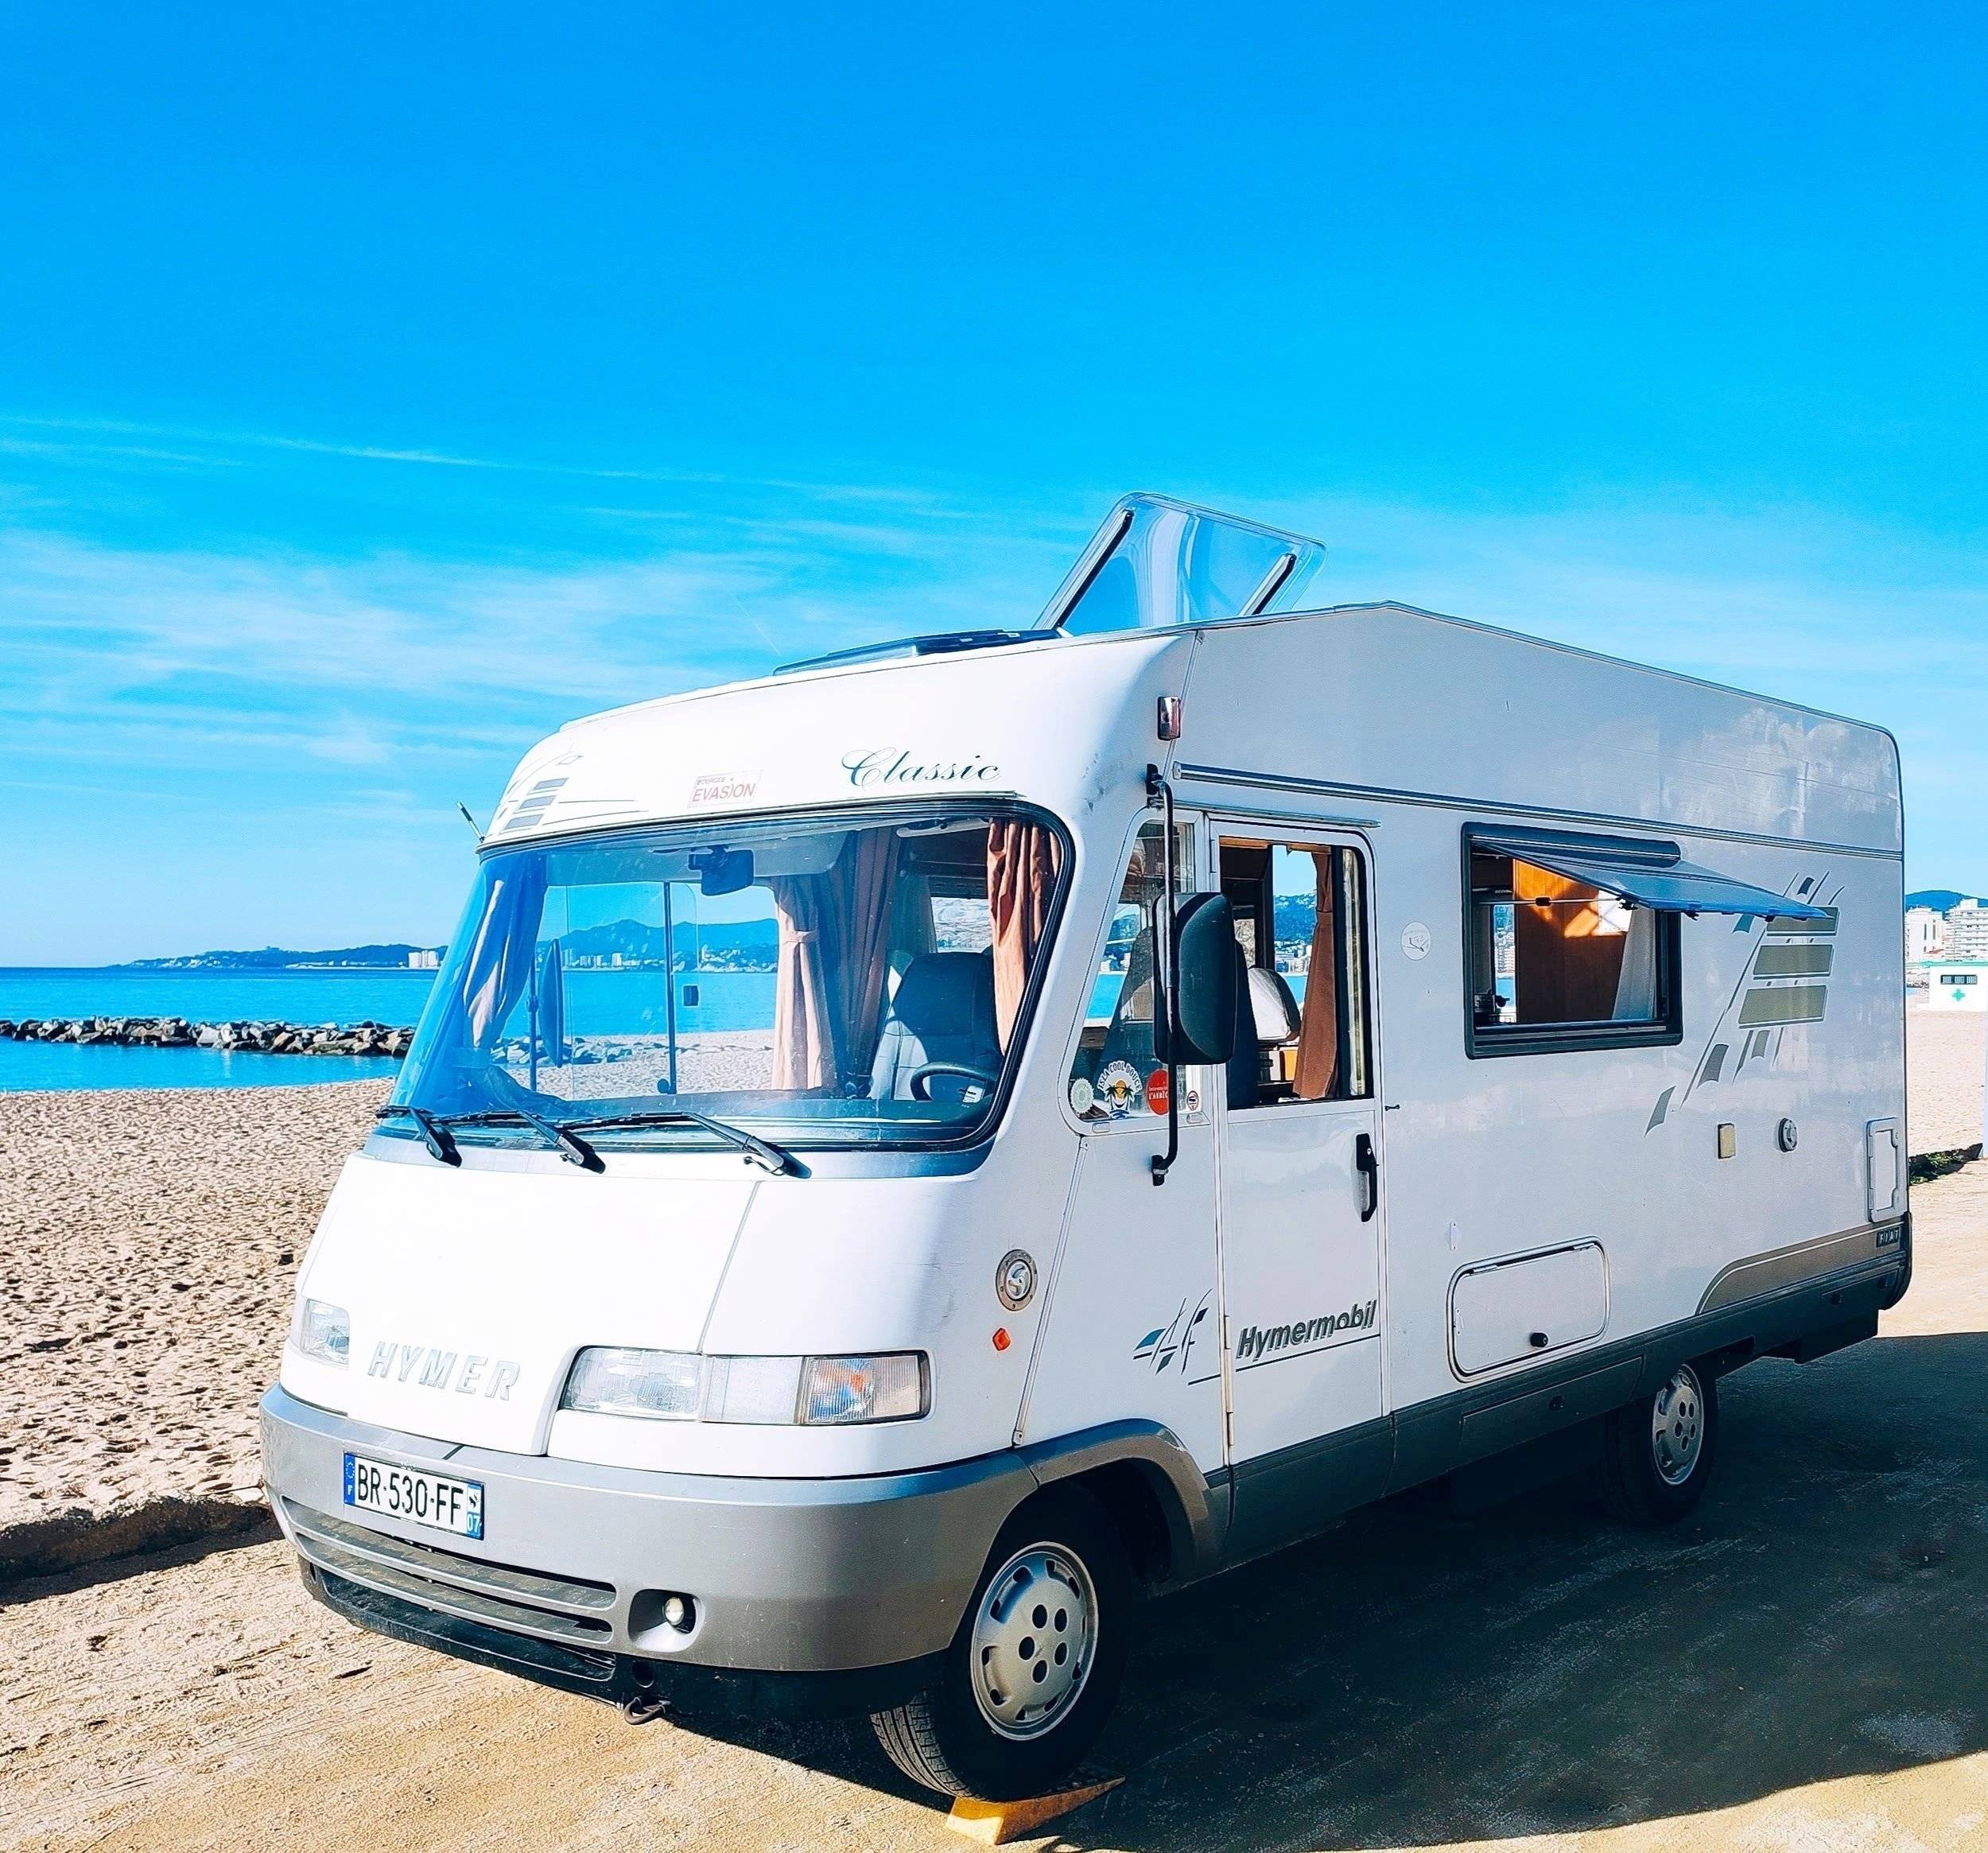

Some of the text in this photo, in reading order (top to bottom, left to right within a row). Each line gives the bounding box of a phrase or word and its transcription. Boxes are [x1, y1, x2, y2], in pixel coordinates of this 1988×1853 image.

[841, 747, 1000, 790] Classic
[692, 783, 756, 802] EVASION
[1097, 1062, 1142, 1090] ISLA COOL DOUCE
[1880, 1230, 1899, 1245] FIAT
[1236, 1299, 1376, 1362] Hymermobil
[367, 1341, 520, 1401] HYMER
[348, 1484, 352, 1496] F
[467, 1513, 480, 1533] 07
